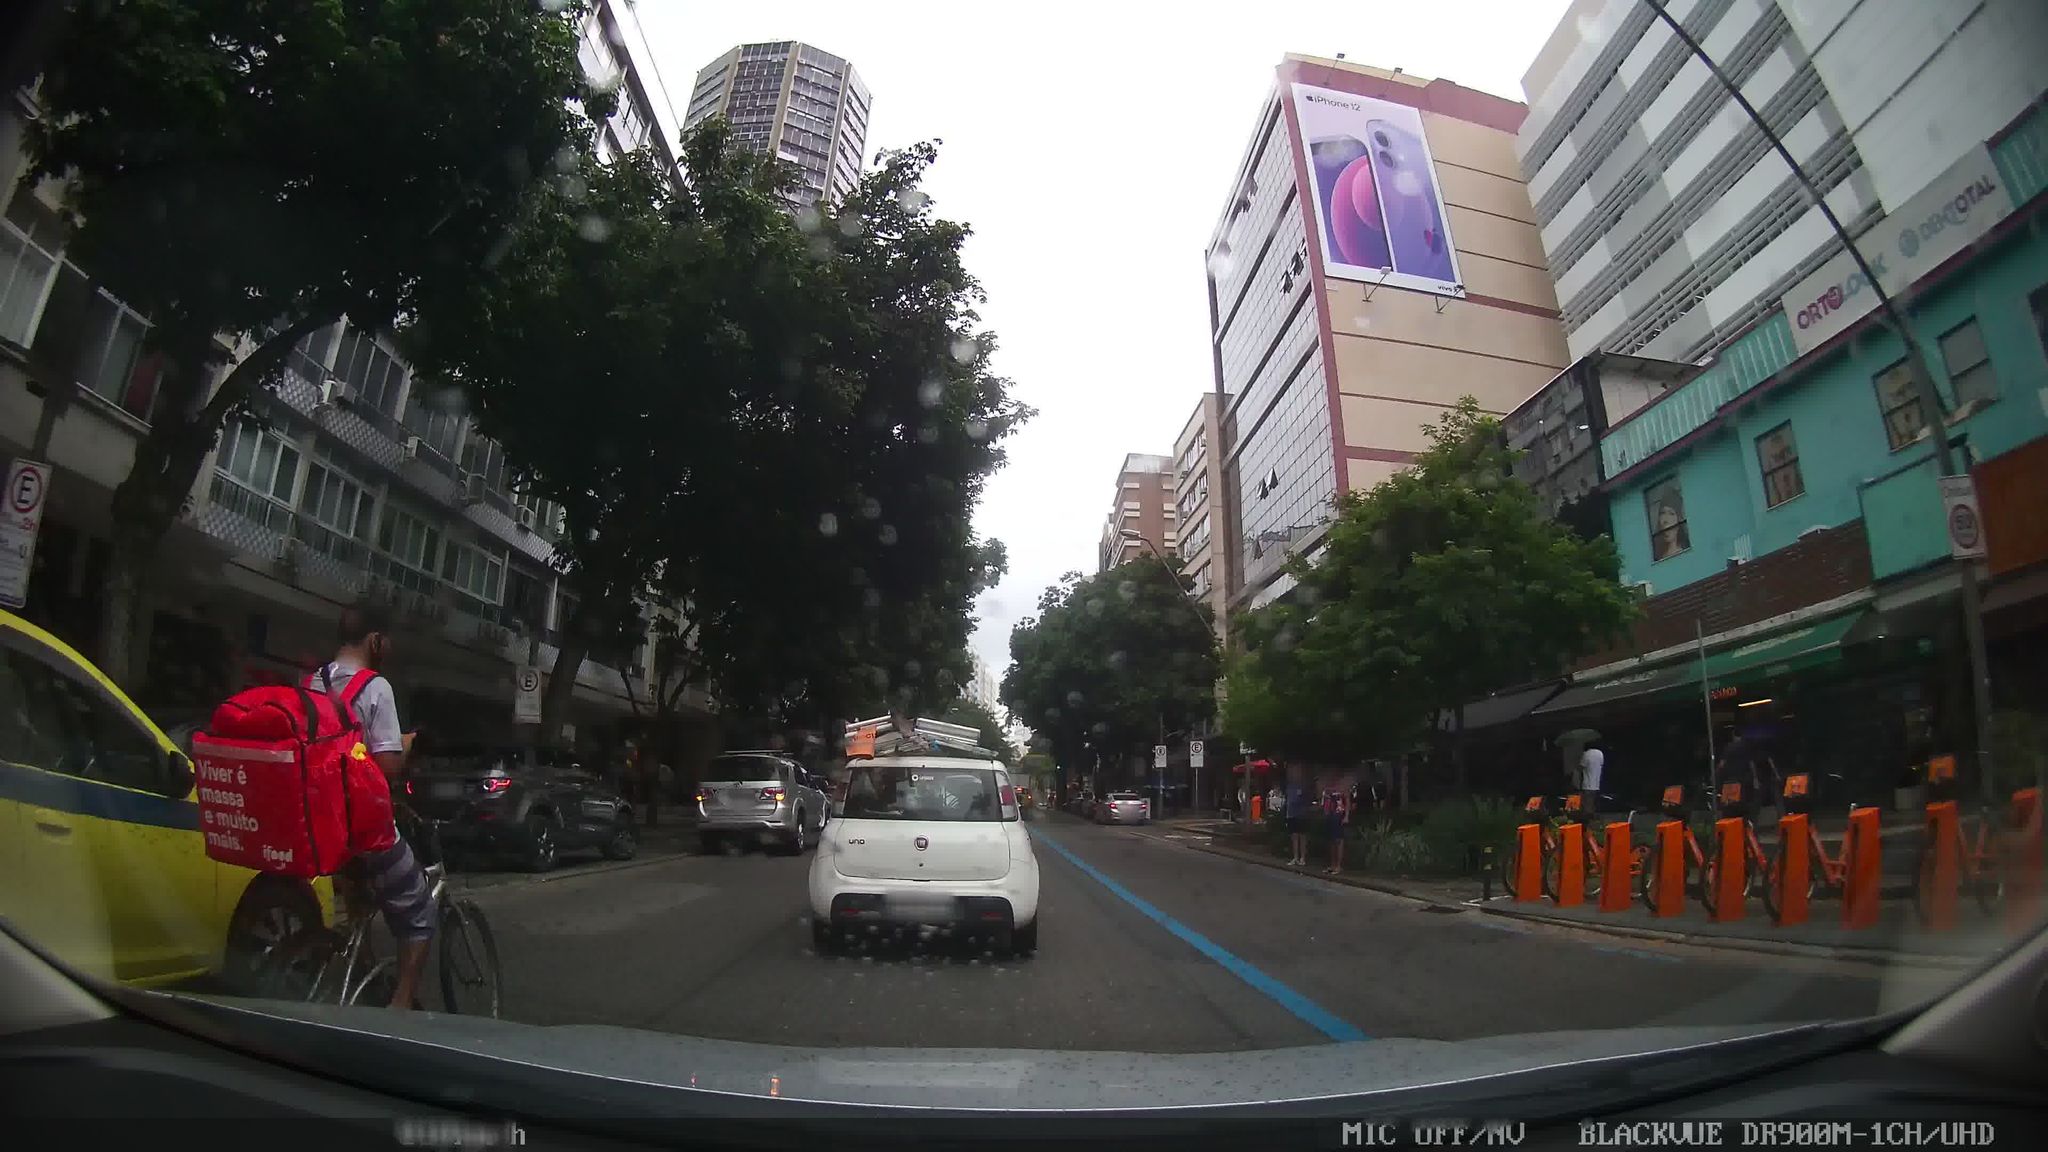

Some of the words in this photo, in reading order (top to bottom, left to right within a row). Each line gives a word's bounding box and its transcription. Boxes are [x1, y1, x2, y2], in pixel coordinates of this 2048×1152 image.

[1314, 95, 1349, 109] iPhone
[1351, 102, 1361, 112] 12
[17, 475, 34, 504] E
[200, 760, 232, 783] Viver
[237, 765, 247, 785] é
[201, 788, 244, 807] massa
[205, 810, 213, 823] e
[217, 811, 259, 832] muito
[208, 830, 244, 851] mais.
